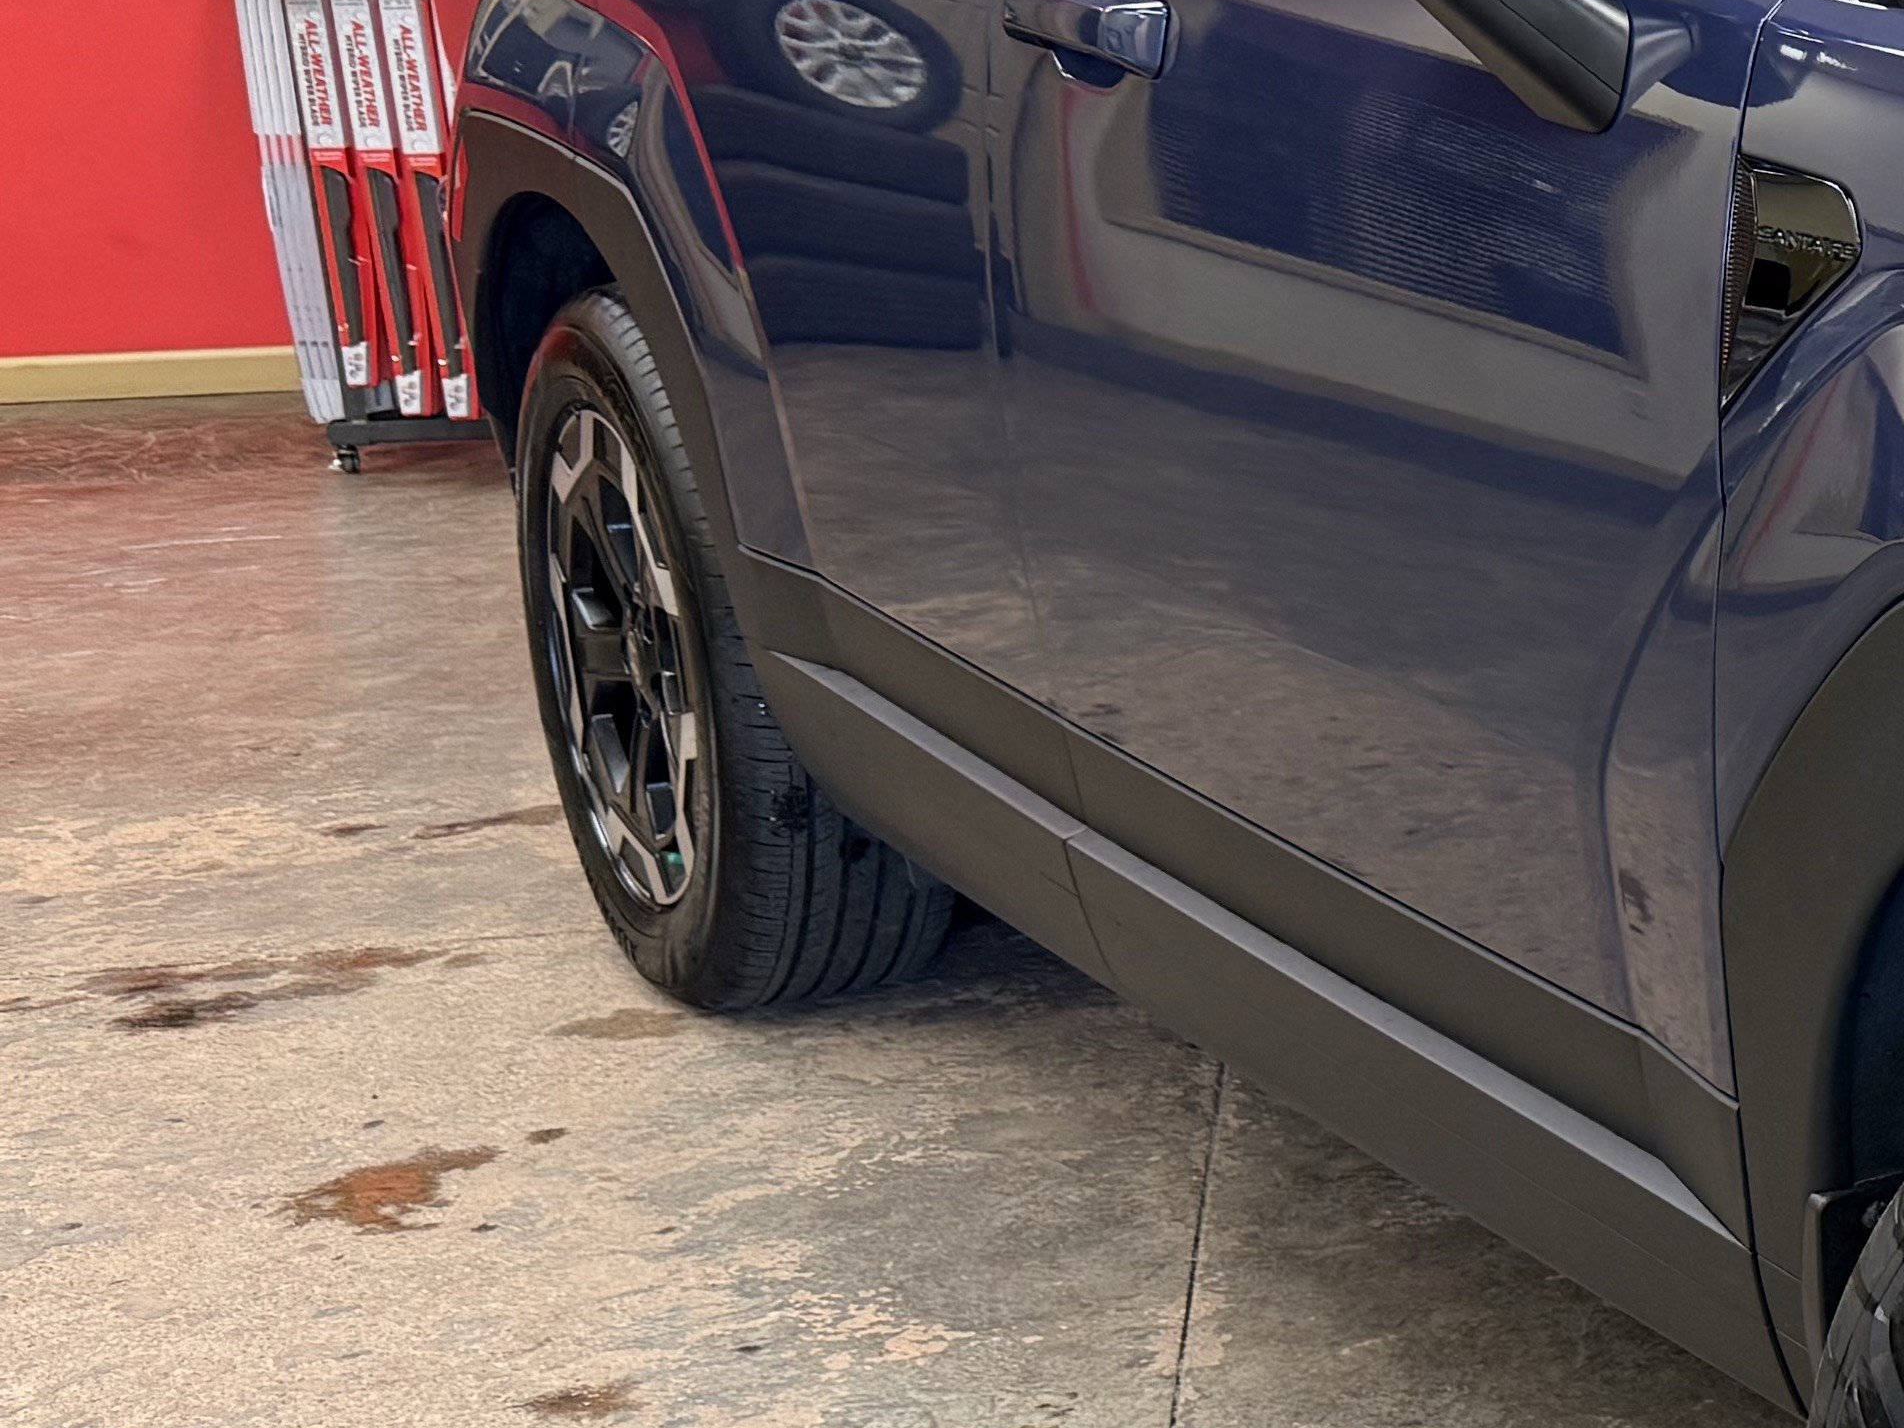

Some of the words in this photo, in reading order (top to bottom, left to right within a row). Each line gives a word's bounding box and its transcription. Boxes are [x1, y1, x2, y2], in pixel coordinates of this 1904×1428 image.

[303, 18, 333, 126] ALL-WEATHER
[350, 19, 380, 128] ALL-WEATHER
[399, 23, 427, 132] ALL-WEATHER
